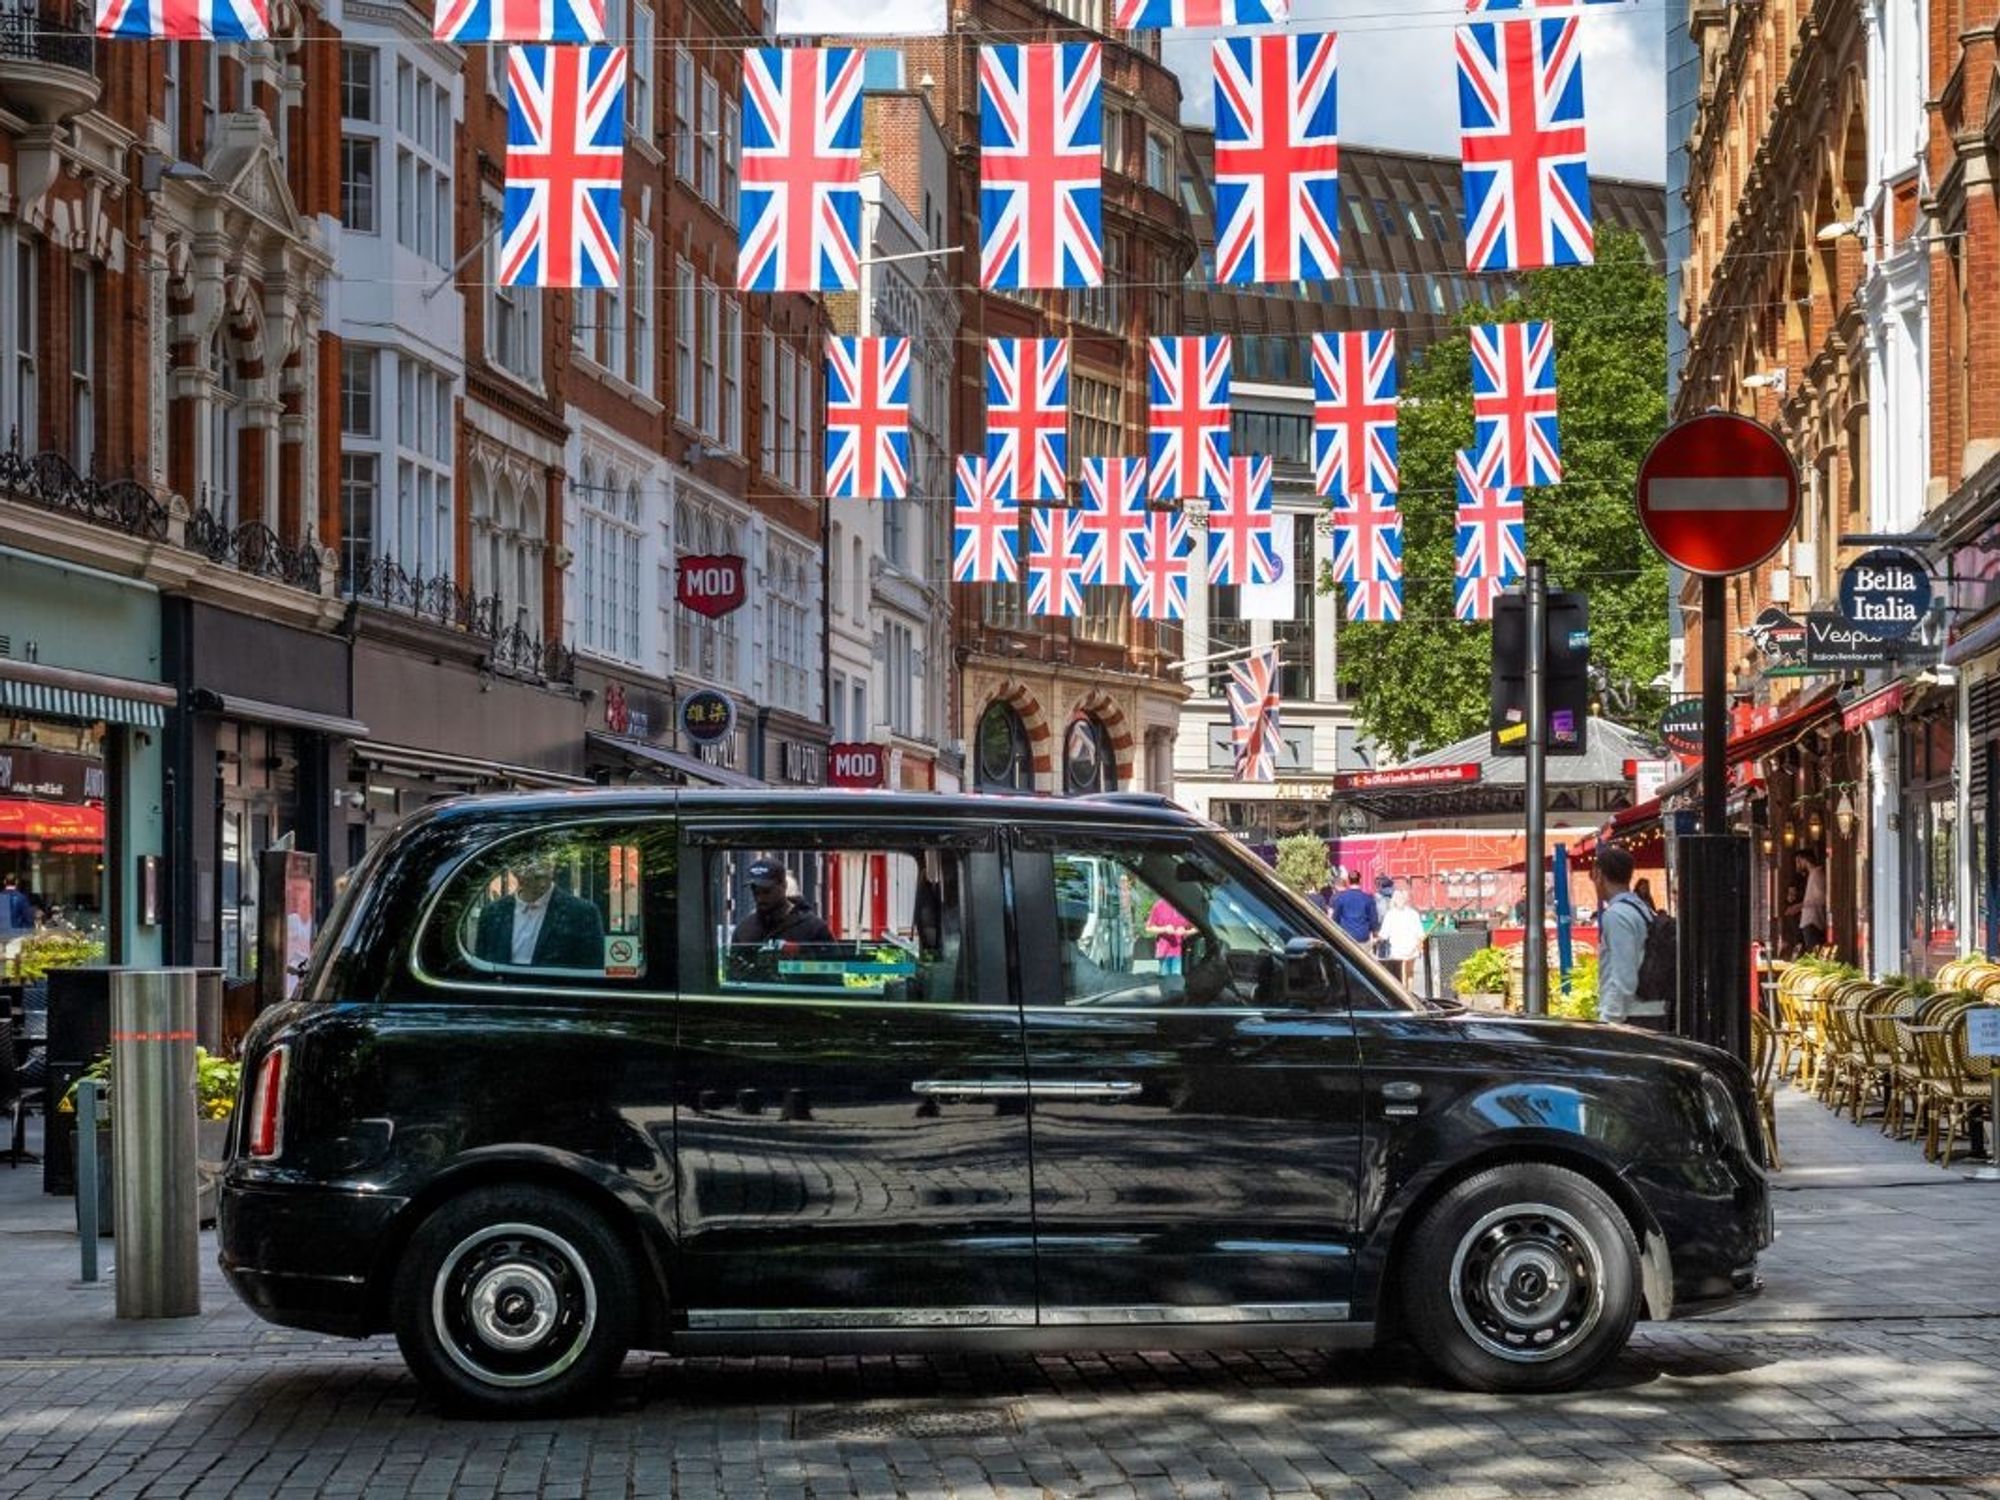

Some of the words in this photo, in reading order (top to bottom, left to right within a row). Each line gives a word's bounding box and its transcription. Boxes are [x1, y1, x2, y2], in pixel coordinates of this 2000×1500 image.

[686, 568, 735, 596] MOD
[1854, 567, 1917, 591] Bella
[1853, 596, 1917, 620] Italia
[1664, 722, 1697, 732] LITTLE
[835, 753, 876, 777] MOD
